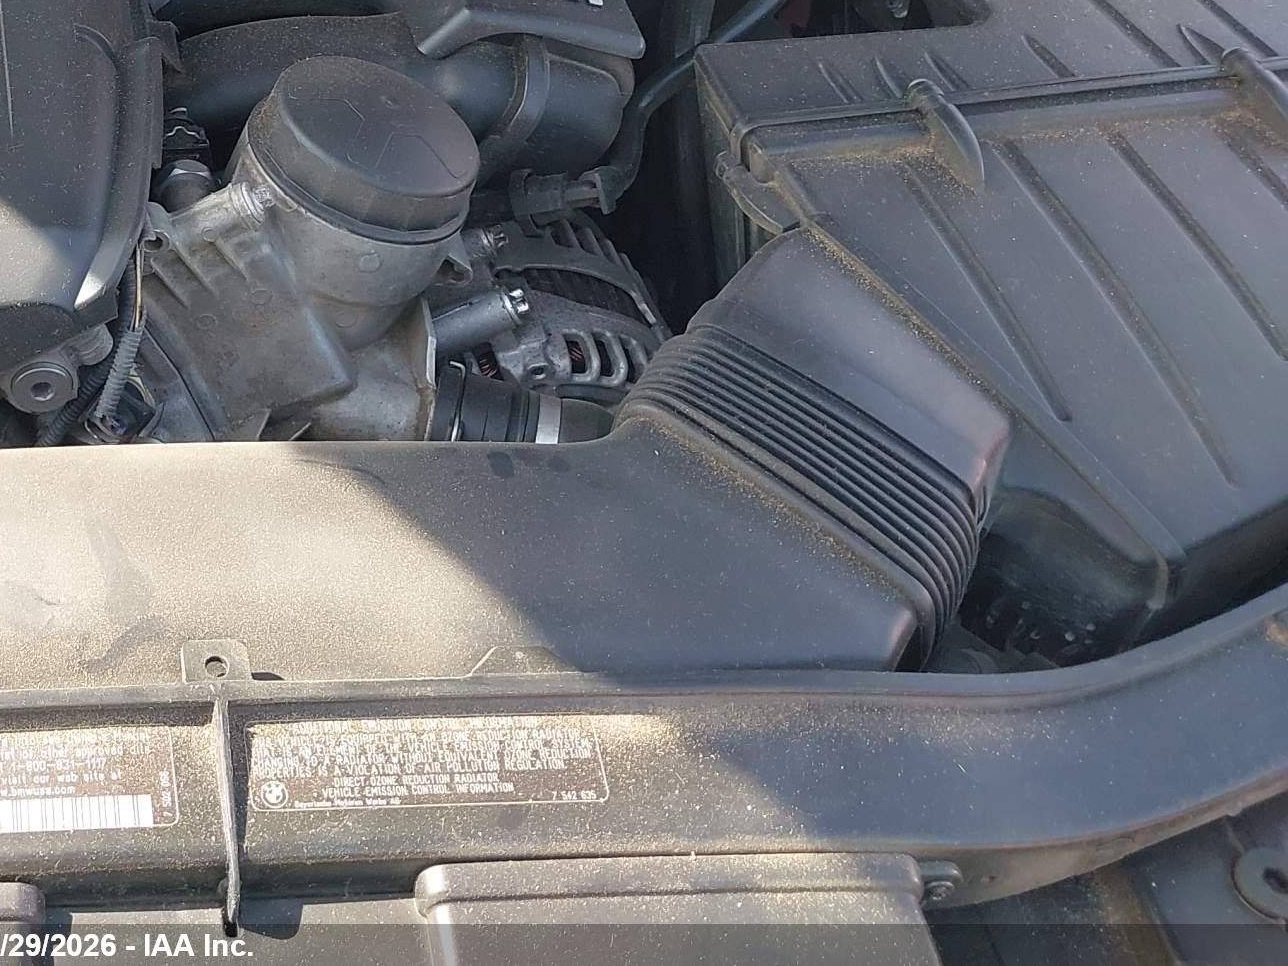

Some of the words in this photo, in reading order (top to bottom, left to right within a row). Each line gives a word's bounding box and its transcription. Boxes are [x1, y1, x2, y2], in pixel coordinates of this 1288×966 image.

[361, 718, 412, 732] EMISSION
[277, 735, 318, 748] VEHICLE
[340, 732, 388, 746] EQUIPPED
[440, 729, 469, 743] OZONE
[475, 728, 529, 742] REDUCTION
[22, 748, 33, 760] of
[40, 746, 67, 759] other
[74, 744, 123, 760] approved
[317, 743, 360, 758] ELEMENT
[407, 740, 449, 754] VEHICLE
[455, 739, 501, 753] EMISSION
[505, 737, 546, 751] CONTROL
[336, 753, 384, 767] RADIATOR
[392, 751, 433, 765] WITHOUT
[438, 749, 500, 763] EQUIVALENT
[504, 748, 536, 761] OZONE
[540, 746, 591, 760] REDUCTION
[11, 756, 106, 773] 1-800-831-1117
[250, 765, 313, 780] PROPERTIES
[317, 764, 329, 777] IS
[347, 762, 402, 776] VIOLATION
[405, 761, 416, 774] OF
[423, 761, 441, 774] AIR
[447, 759, 500, 773] POLLUTION
[0, 772, 26, 786] visit
[32, 774, 49, 785] our
[57, 772, 78, 783] web
[83, 769, 105, 782] site
[111, 768, 122, 781] at
[334, 775, 366, 789] DIRECT
[370, 774, 399, 787] OZONE
[402, 772, 450, 787] REDUCTION
[454, 771, 499, 784] RADIATOR
[321, 785, 362, 799] VEHICLE
[365, 783, 409, 797] EMISSION
[412, 781, 450, 795] CONTROL
[455, 780, 514, 794] INFORMATION
[561, 790, 577, 802] 542
